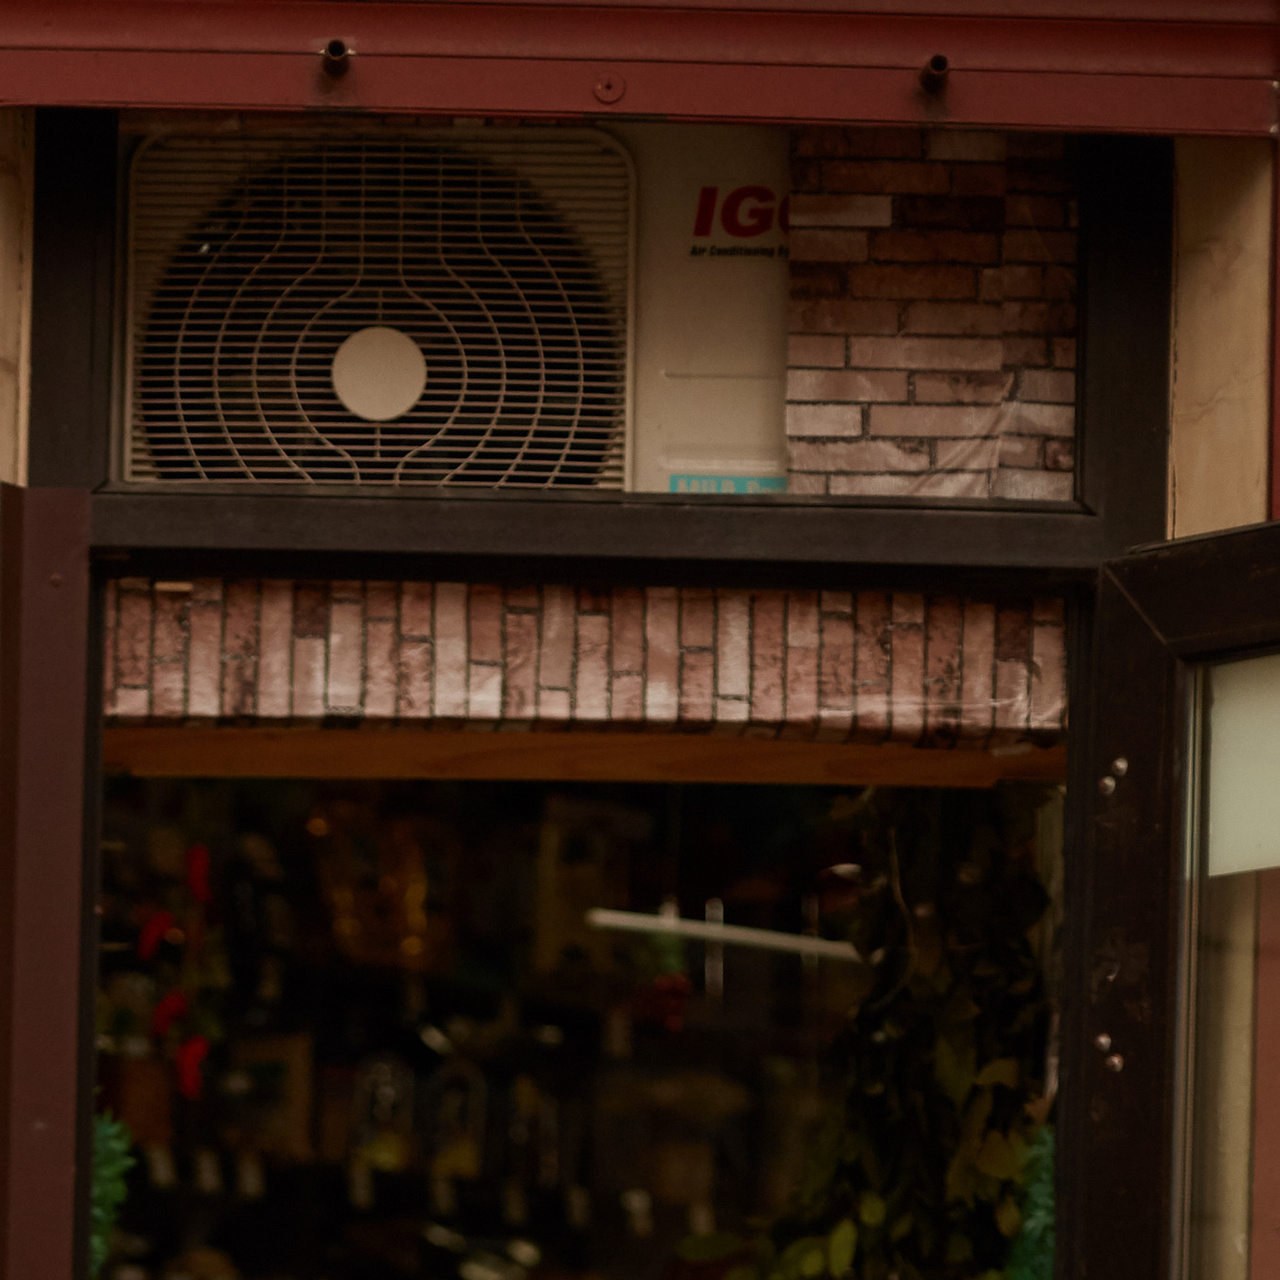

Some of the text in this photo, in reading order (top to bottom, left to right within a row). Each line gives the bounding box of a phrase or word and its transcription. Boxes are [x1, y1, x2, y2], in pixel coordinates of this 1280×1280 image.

[694, 185, 790, 237] IG
[690, 246, 708, 256] Air
[710, 246, 775, 258] Conditioning
